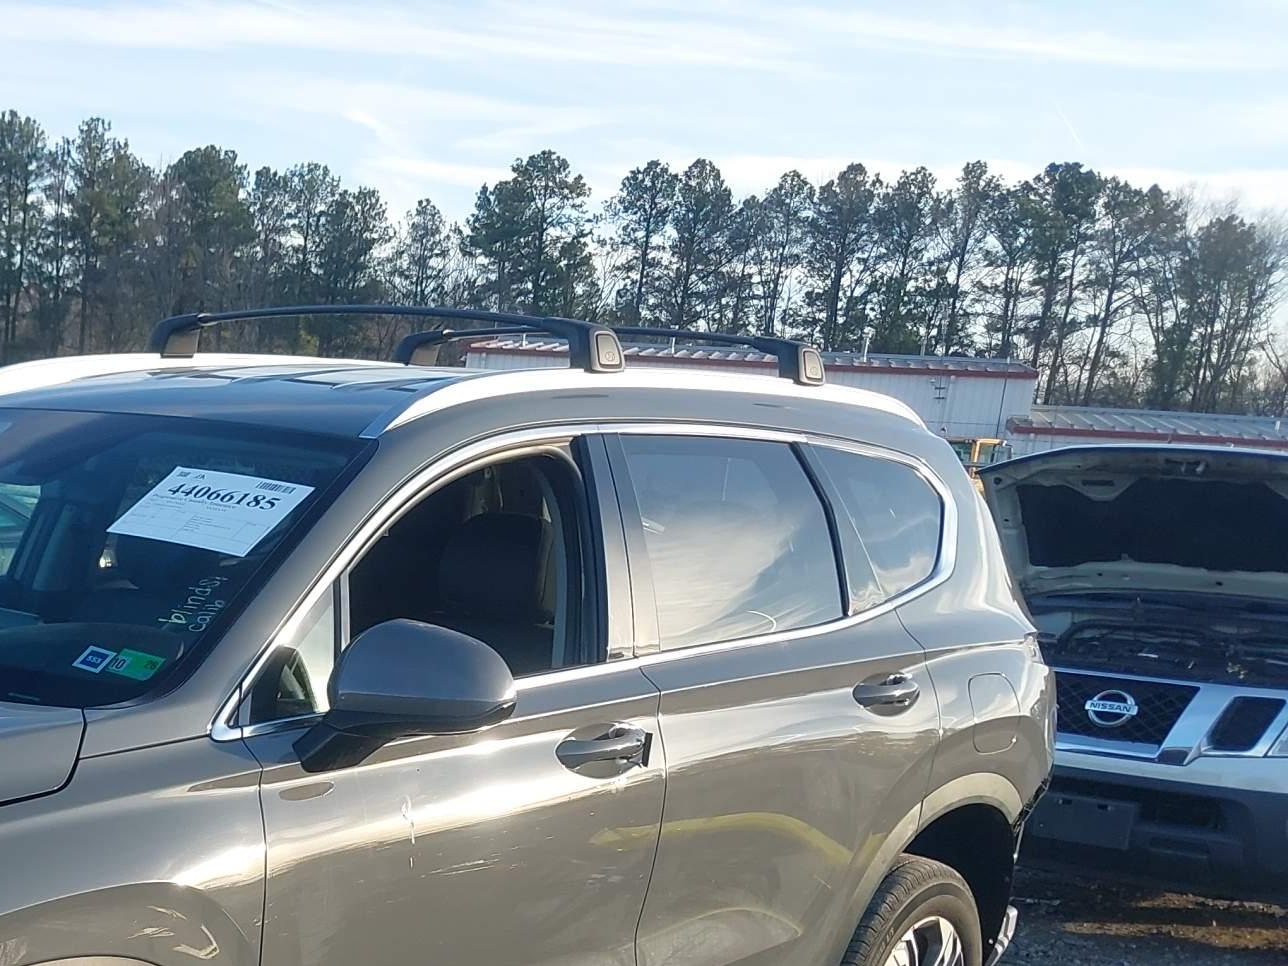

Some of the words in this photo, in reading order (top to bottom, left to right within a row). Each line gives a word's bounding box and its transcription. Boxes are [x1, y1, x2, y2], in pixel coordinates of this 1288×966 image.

[168, 483, 281, 511] 44066185
[111, 657, 127, 670] 10
[1089, 702, 1132, 712] NISSAN
